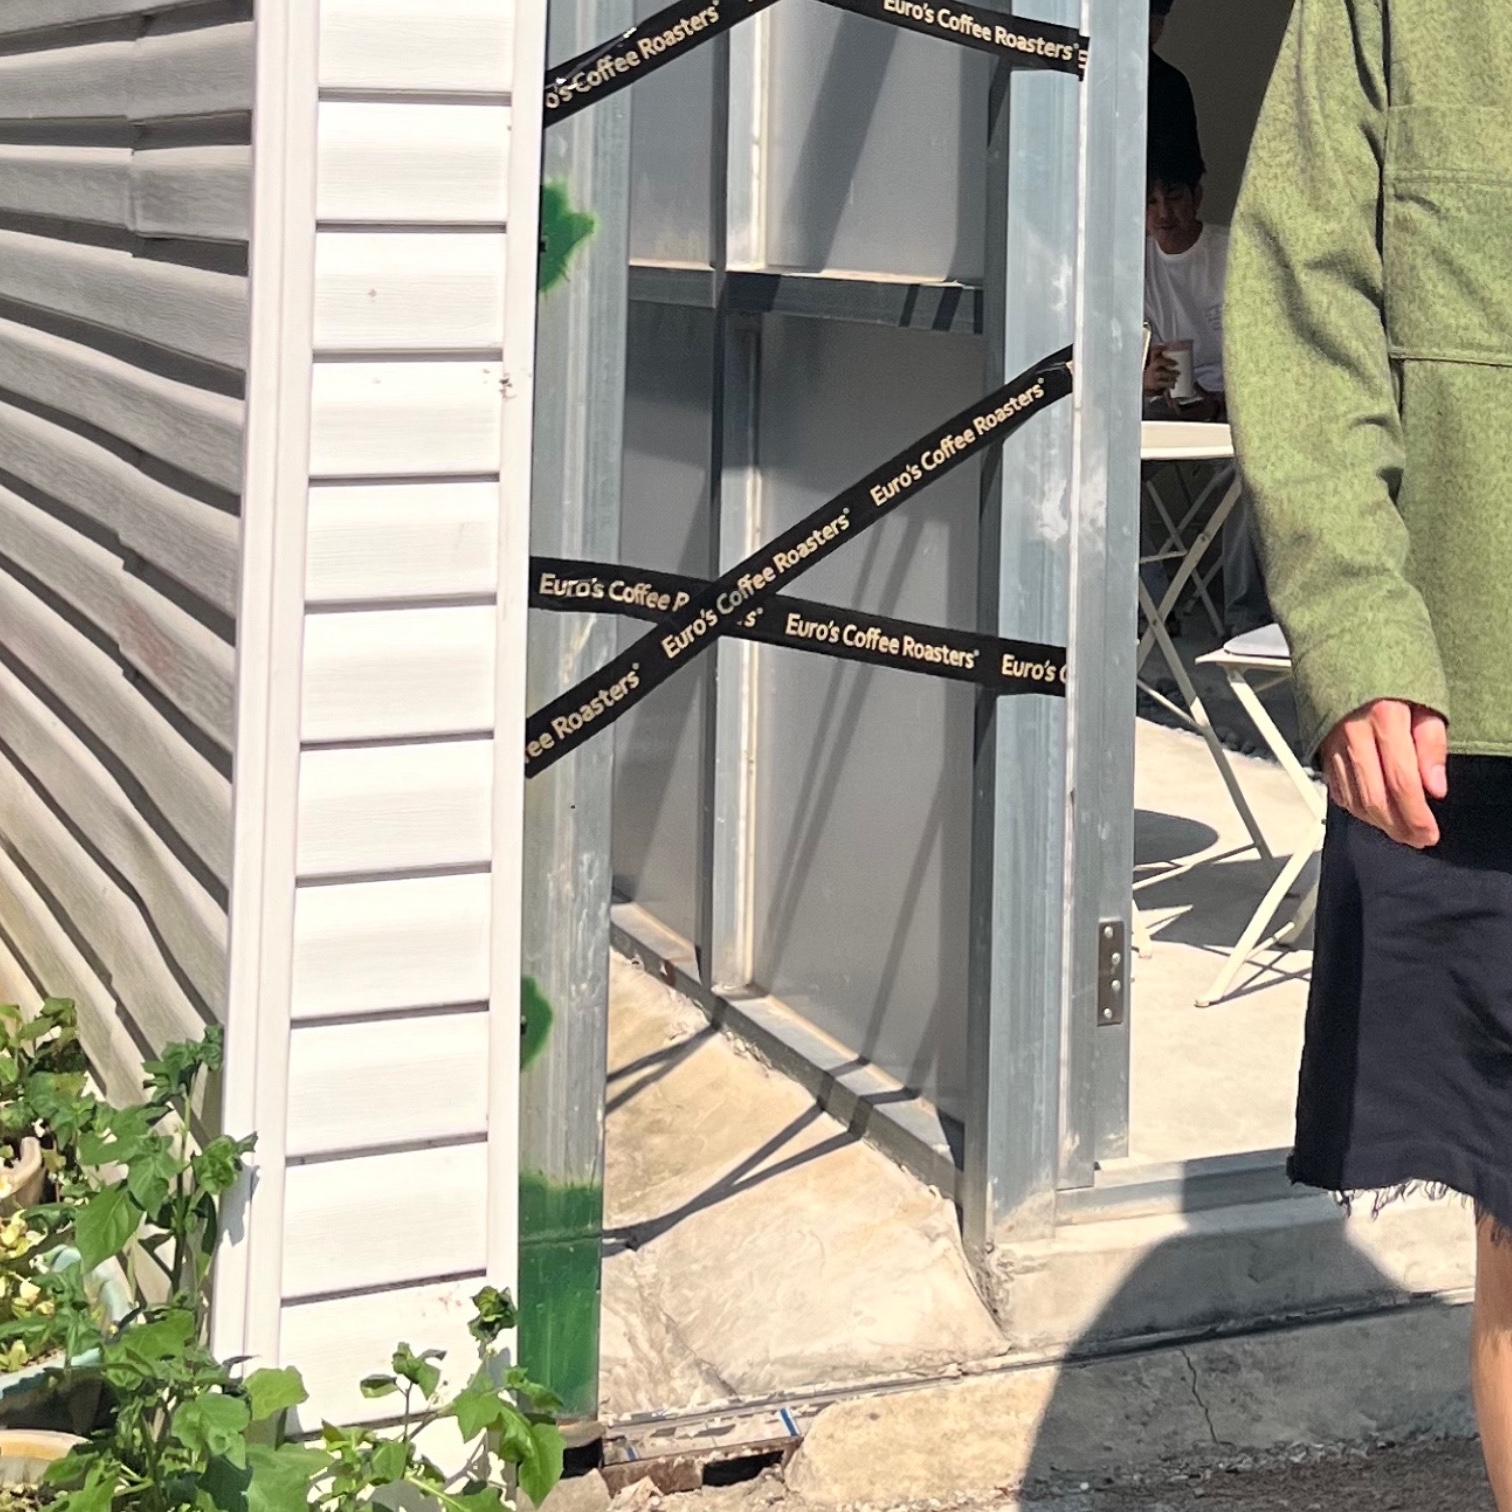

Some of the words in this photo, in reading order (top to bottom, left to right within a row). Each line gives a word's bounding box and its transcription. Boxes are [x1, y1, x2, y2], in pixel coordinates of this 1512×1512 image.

[545, 84, 573, 109] o's
[571, 50, 641, 93] Coffee
[637, 5, 720, 59] Roasters
[937, 8, 992, 41] Coffee
[994, 25, 1073, 61] Roasters
[869, 464, 922, 506] Euro's
[920, 428, 976, 470] Coffee
[972, 383, 1045, 435] Roasters
[539, 572, 604, 599] Euro's
[608, 580, 671, 610] Coffee
[660, 607, 719, 659] Euro's
[716, 566, 777, 615] Coffee
[772, 513, 850, 573] Roasters
[785, 612, 840, 643] Euro's
[842, 624, 900, 655] Coffee
[902, 635, 976, 669] Roasters
[1001, 653, 1057, 682] Euro's
[550, 670, 640, 740] Roasters
